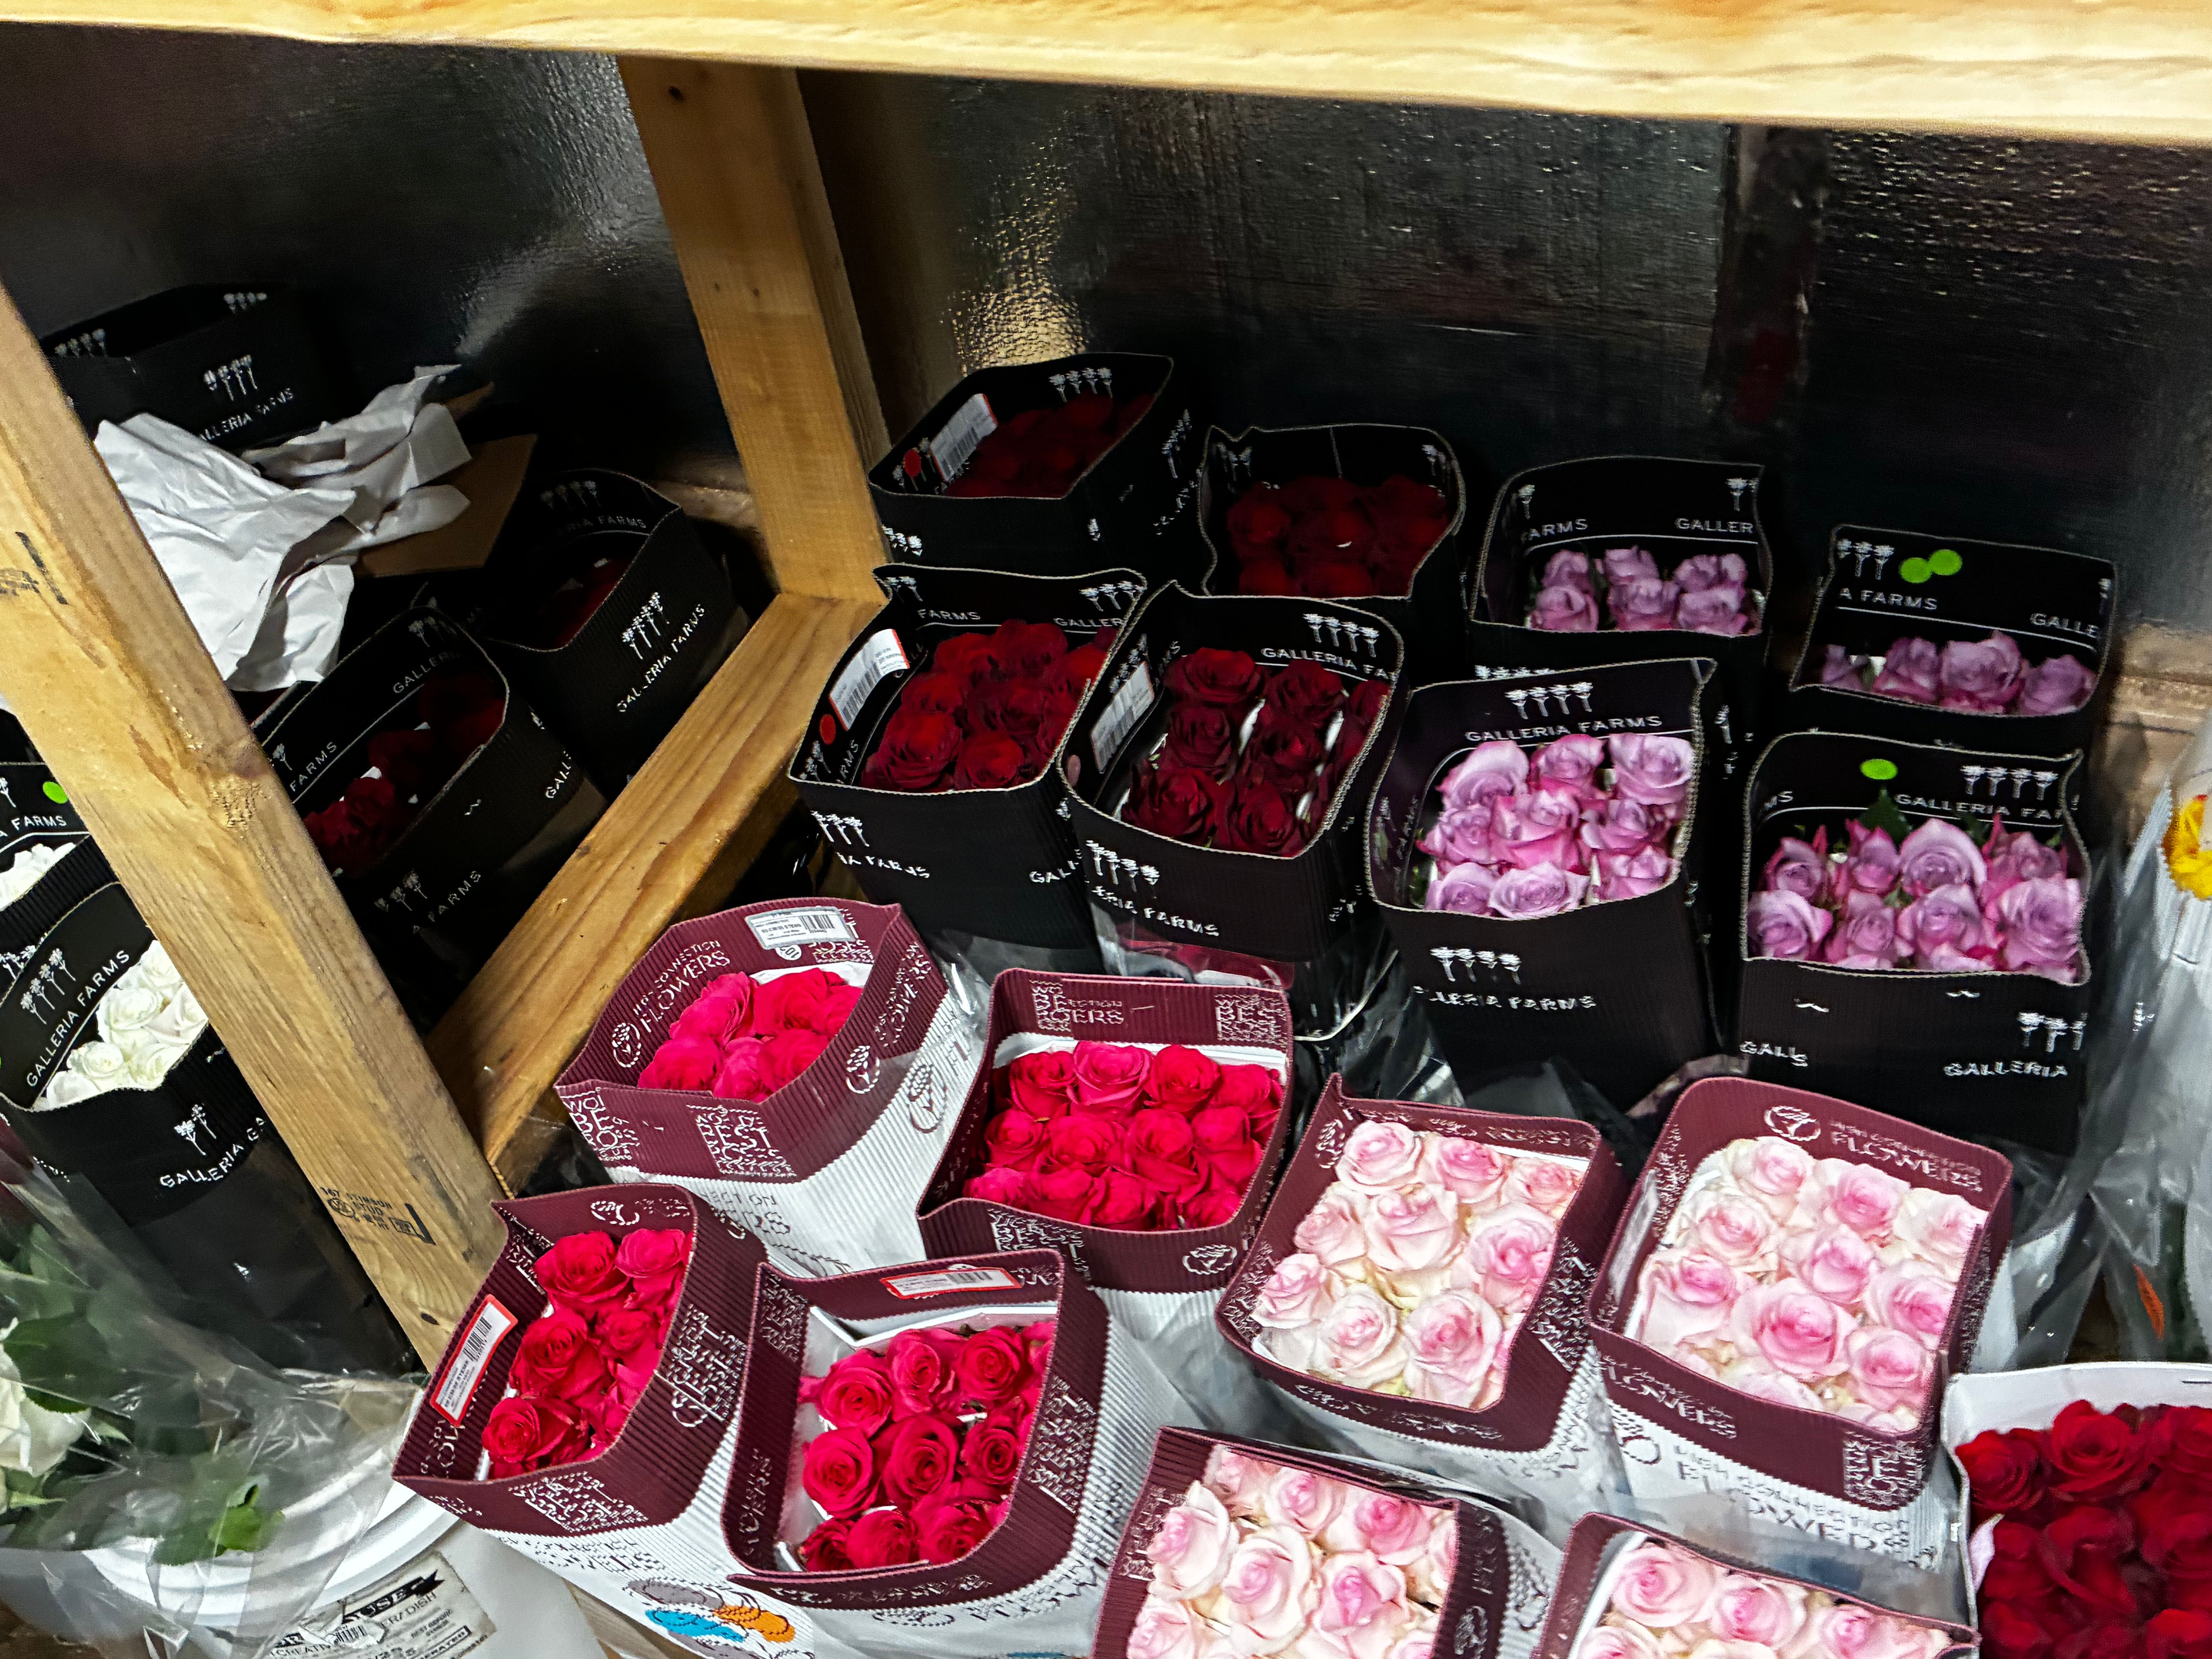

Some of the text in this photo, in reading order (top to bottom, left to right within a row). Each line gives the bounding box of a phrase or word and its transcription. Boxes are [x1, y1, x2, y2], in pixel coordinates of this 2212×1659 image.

[1860, 589, 1937, 611] FARMS
[917, 609, 981, 620] FARMS
[1261, 647, 1357, 670] GALLERIA
[1464, 715, 1663, 742] GALLERIA FARMS
[289, 741, 338, 792] FARMS
[1894, 793, 2011, 816] GALLERIA
[11, 815, 67, 830] FARMS
[640, 950, 731, 1033] FLOWERS
[26, 950, 130, 1087] GALLERIA FARMS
[1943, 1061, 2068, 1078] GALLERIA
[159, 1143, 245, 1188] GALLERIA
